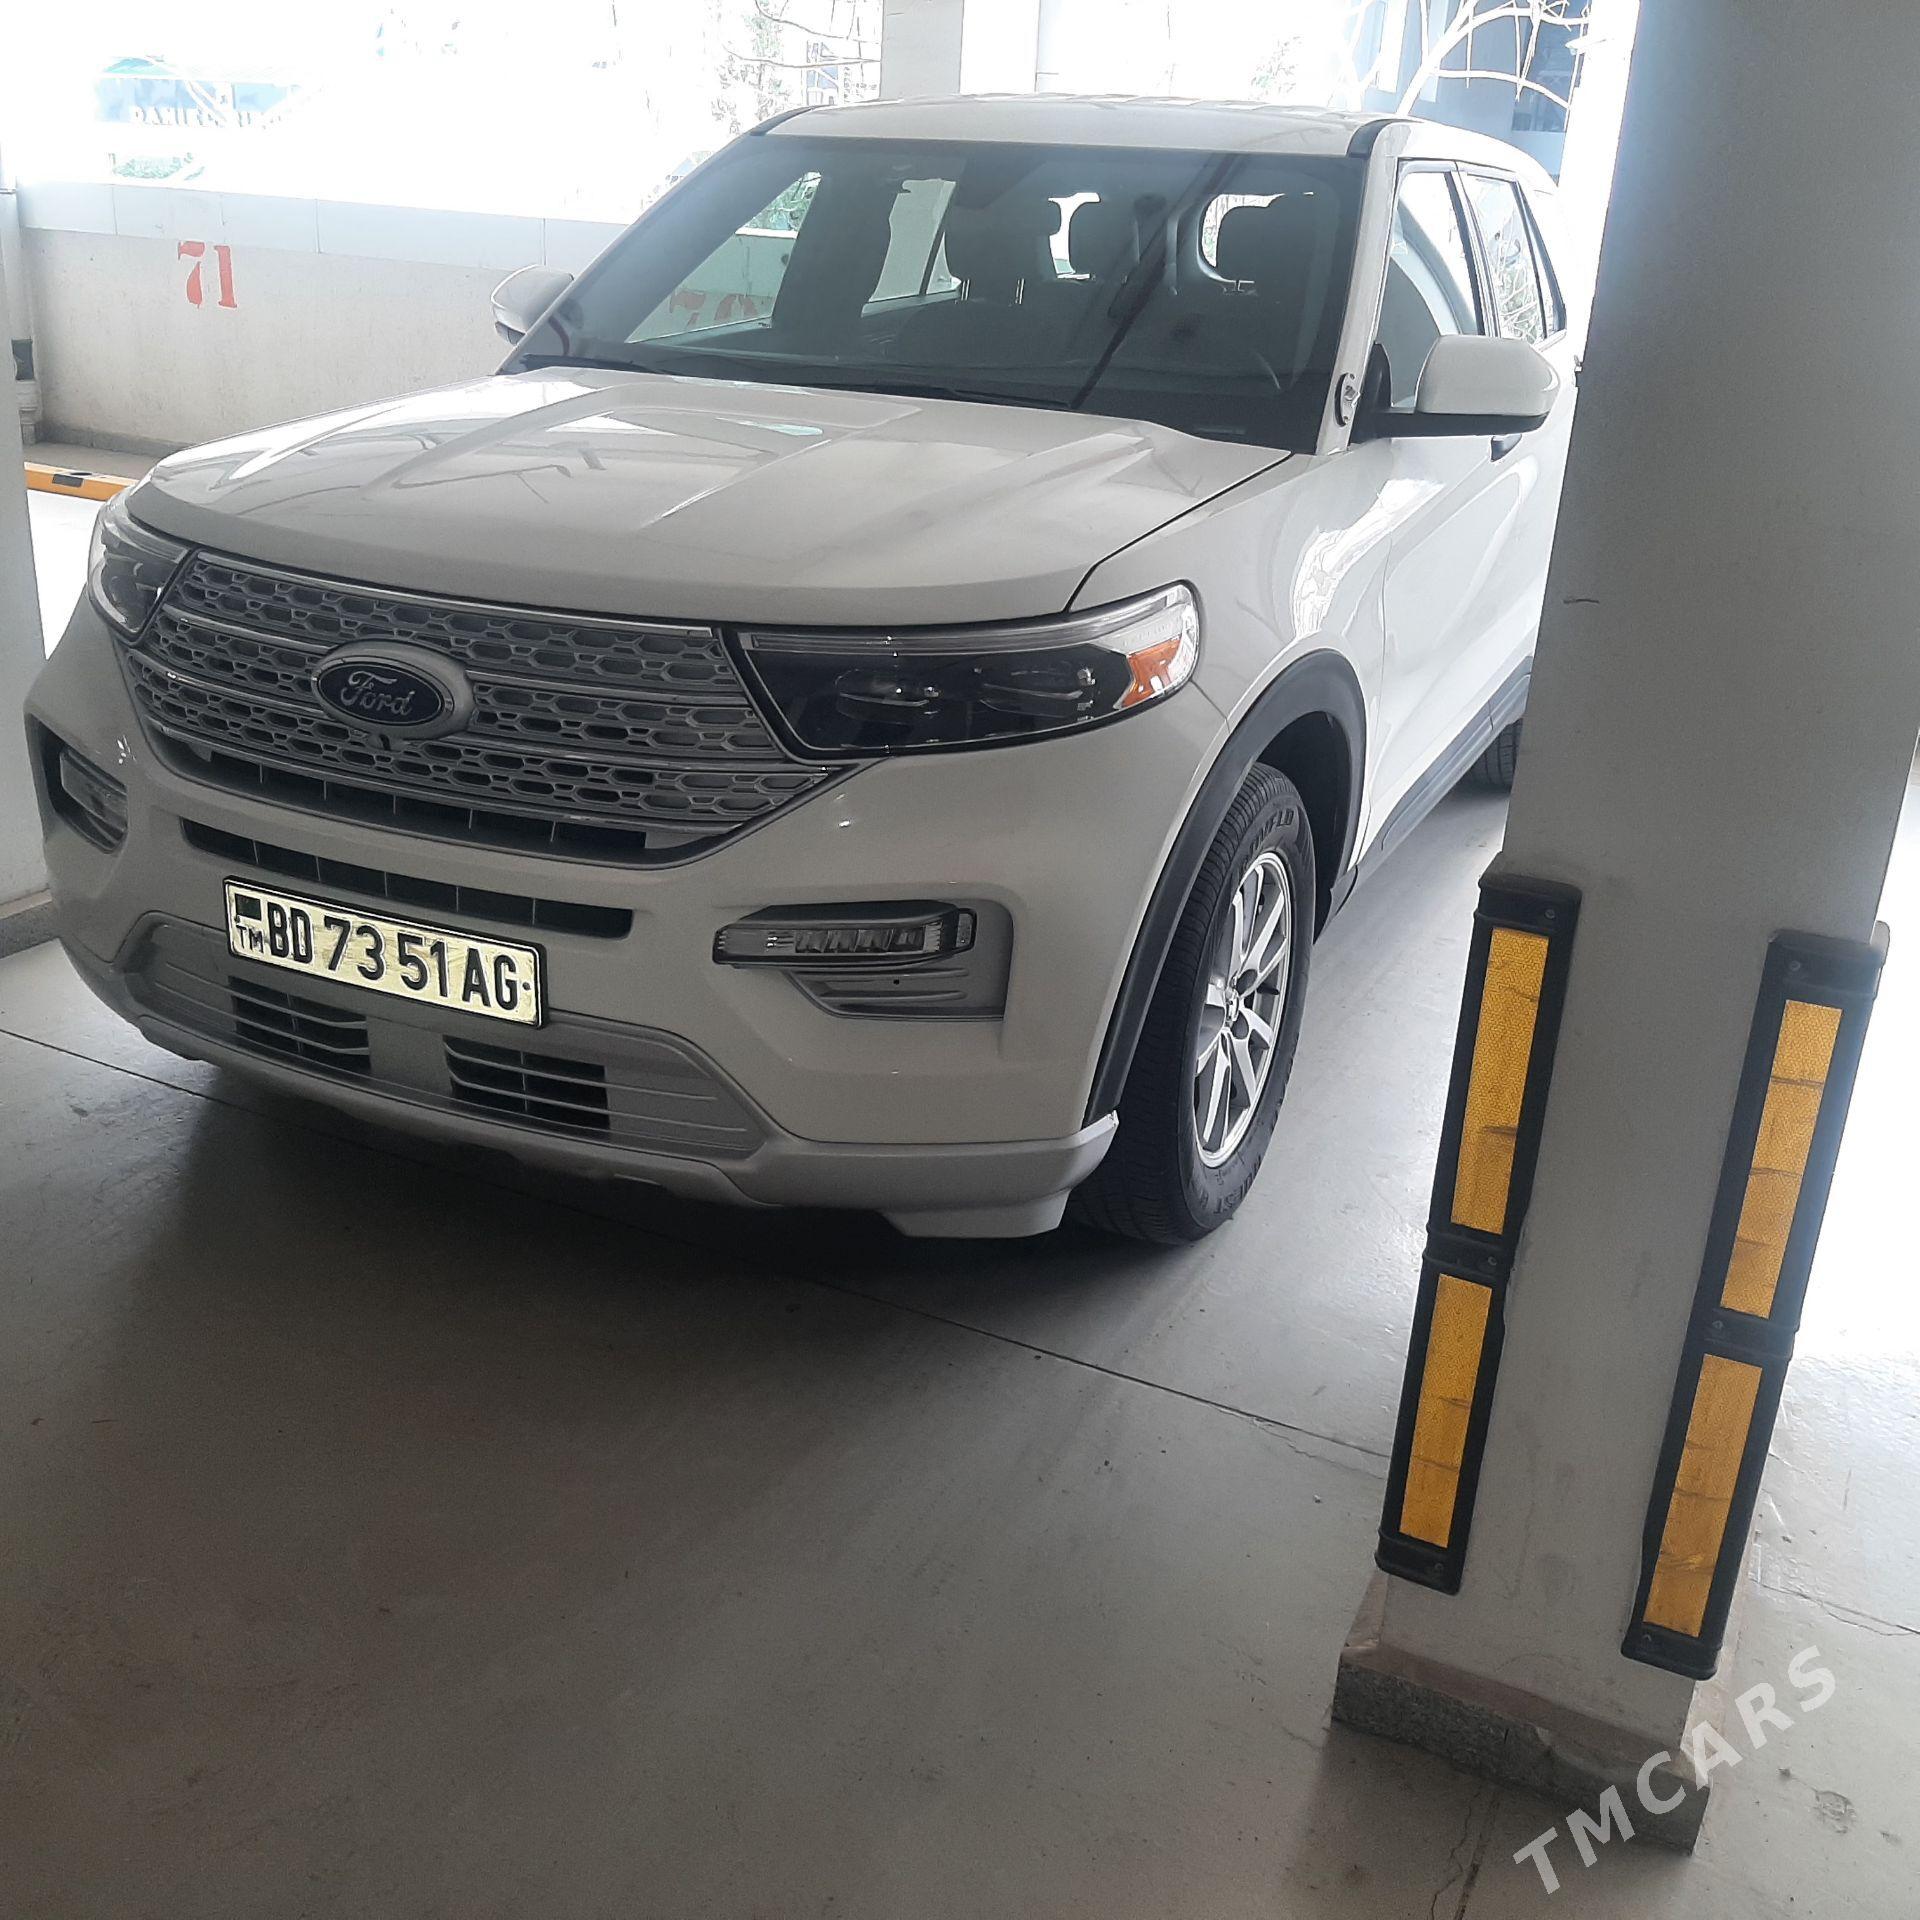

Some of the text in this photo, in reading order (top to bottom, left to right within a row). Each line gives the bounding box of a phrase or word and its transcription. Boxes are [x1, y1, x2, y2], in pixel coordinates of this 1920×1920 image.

[177, 240, 237, 308] 71
[340, 670, 416, 716] Ford
[235, 923, 264, 955] TM
[461, 947, 519, 1011] AG
